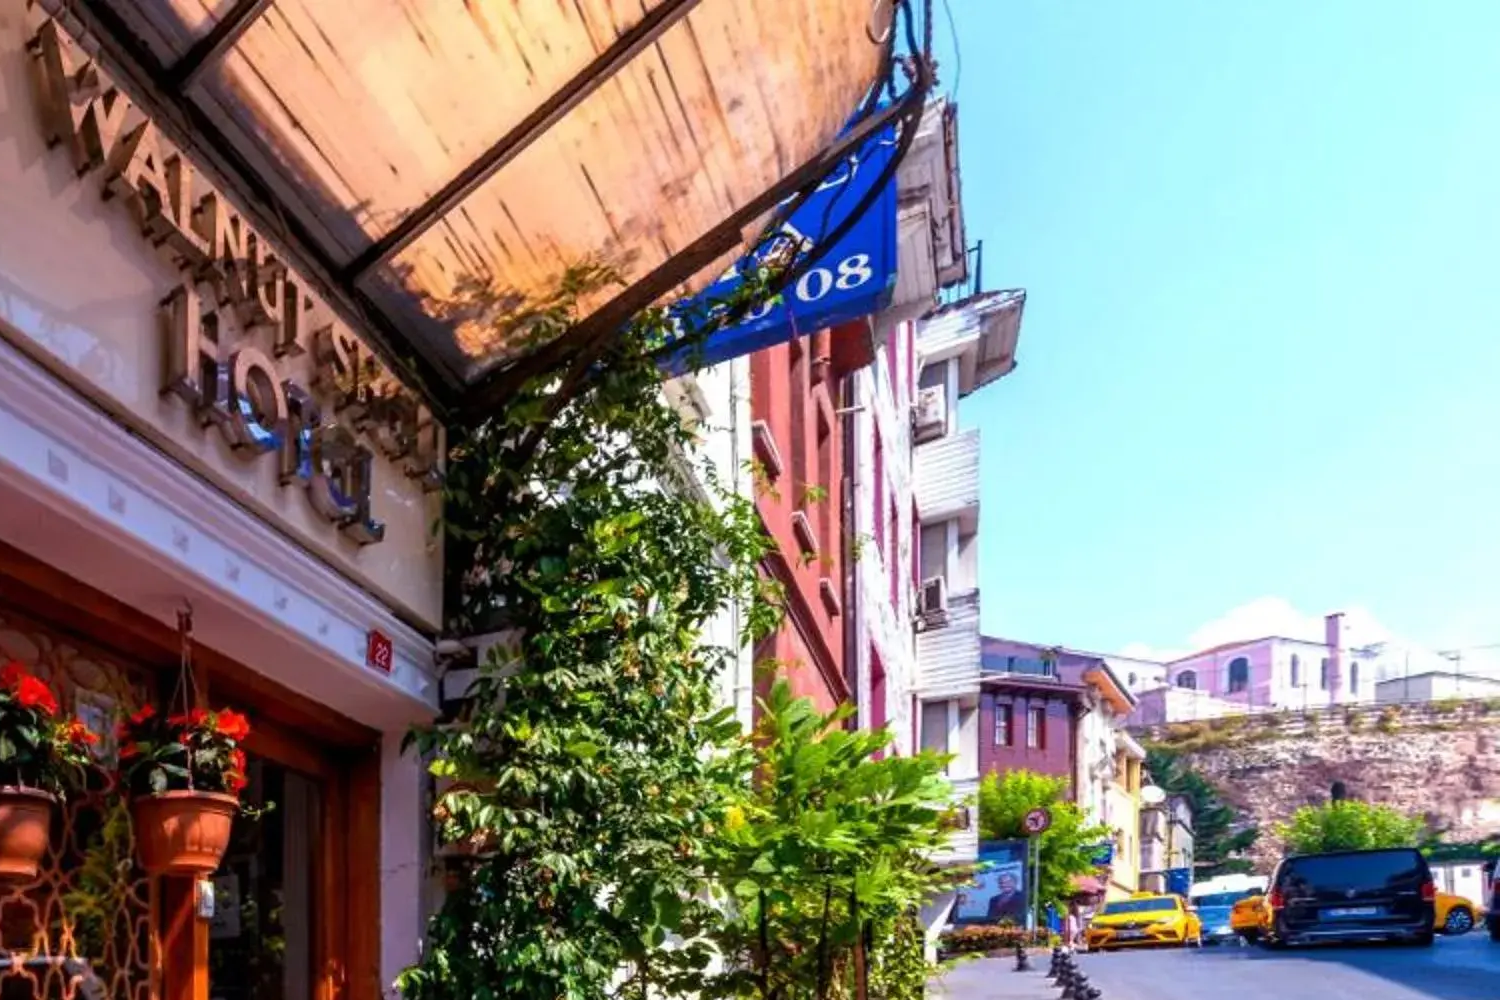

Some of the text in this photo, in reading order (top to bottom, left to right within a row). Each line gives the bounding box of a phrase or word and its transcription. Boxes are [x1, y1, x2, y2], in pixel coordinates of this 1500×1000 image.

[28, 16, 447, 490] WALNUT SHL
[160, 280, 386, 542] HOTEL
